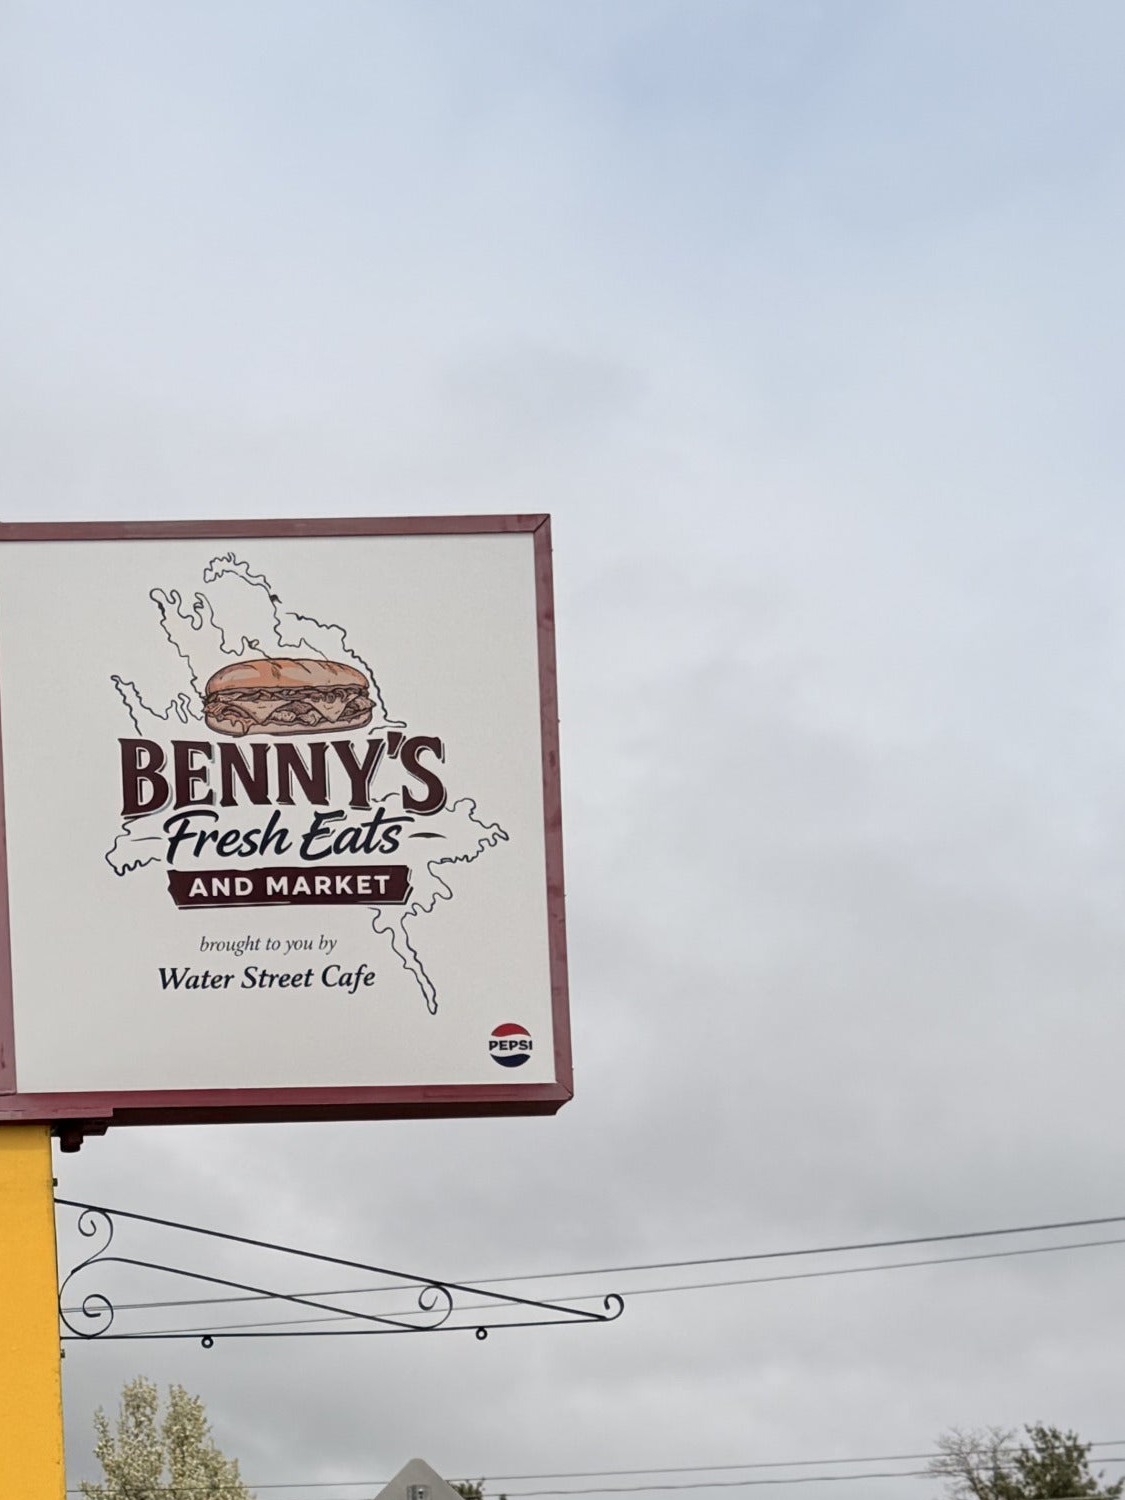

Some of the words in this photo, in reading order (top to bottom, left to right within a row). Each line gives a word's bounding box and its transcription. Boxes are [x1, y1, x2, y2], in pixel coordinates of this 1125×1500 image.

[117, 731, 447, 819] BENNY'S
[162, 810, 294, 864] Fresh
[299, 807, 415, 858] Eats
[188, 877, 253, 898] AND
[266, 874, 391, 896] MARKET
[199, 935, 261, 955] brought
[265, 936, 280, 952] to
[283, 938, 315, 955] you
[318, 934, 338, 954] by
[158, 966, 235, 991] Water
[240, 965, 315, 990] Street
[320, 965, 376, 993] Cafe
[488, 1039, 533, 1053] PEPSI
